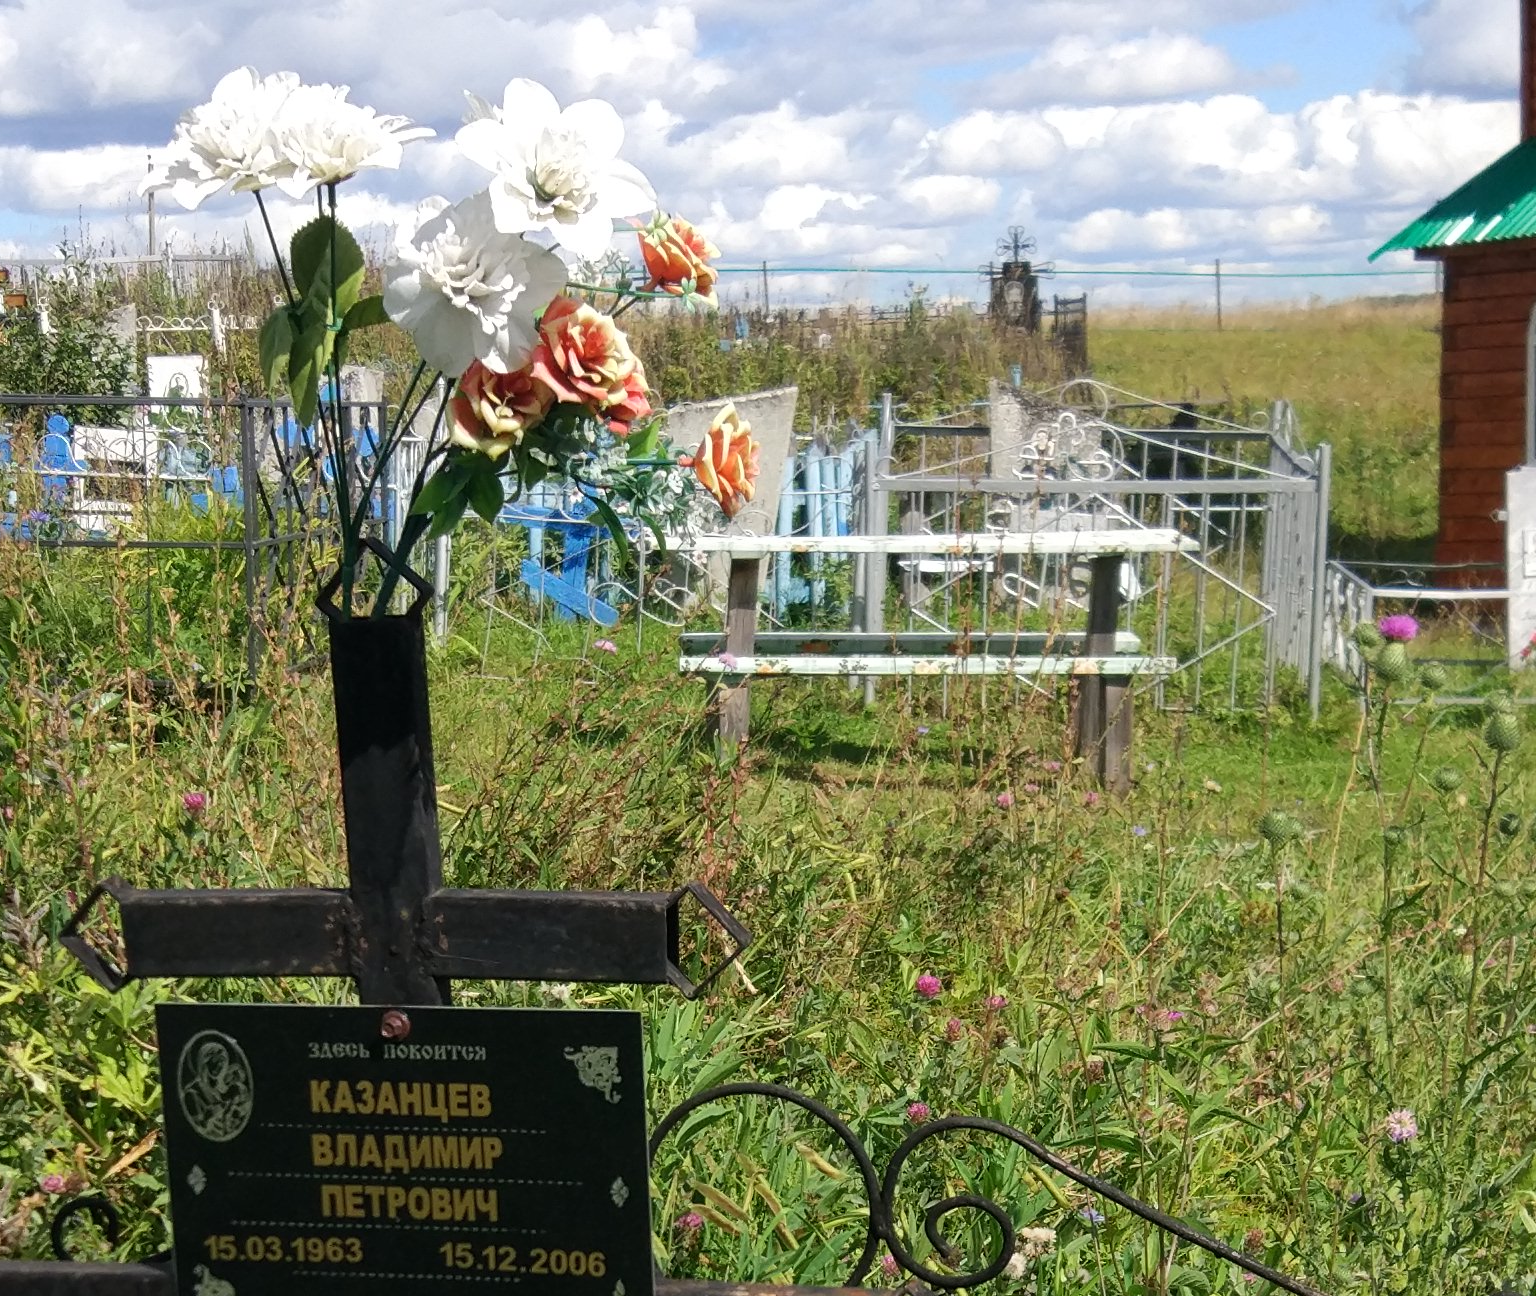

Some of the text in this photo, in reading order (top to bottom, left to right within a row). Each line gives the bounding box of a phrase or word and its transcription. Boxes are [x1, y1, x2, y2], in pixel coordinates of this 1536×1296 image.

[309, 1079, 492, 1123] КАЗАНЦЕВ
[310, 1134, 503, 1174] ВЛАДИМИР
[321, 1185, 499, 1222] ПЕТРОВИЧ
[205, 1235, 606, 1277] 15.03.1963 15.12.2006
